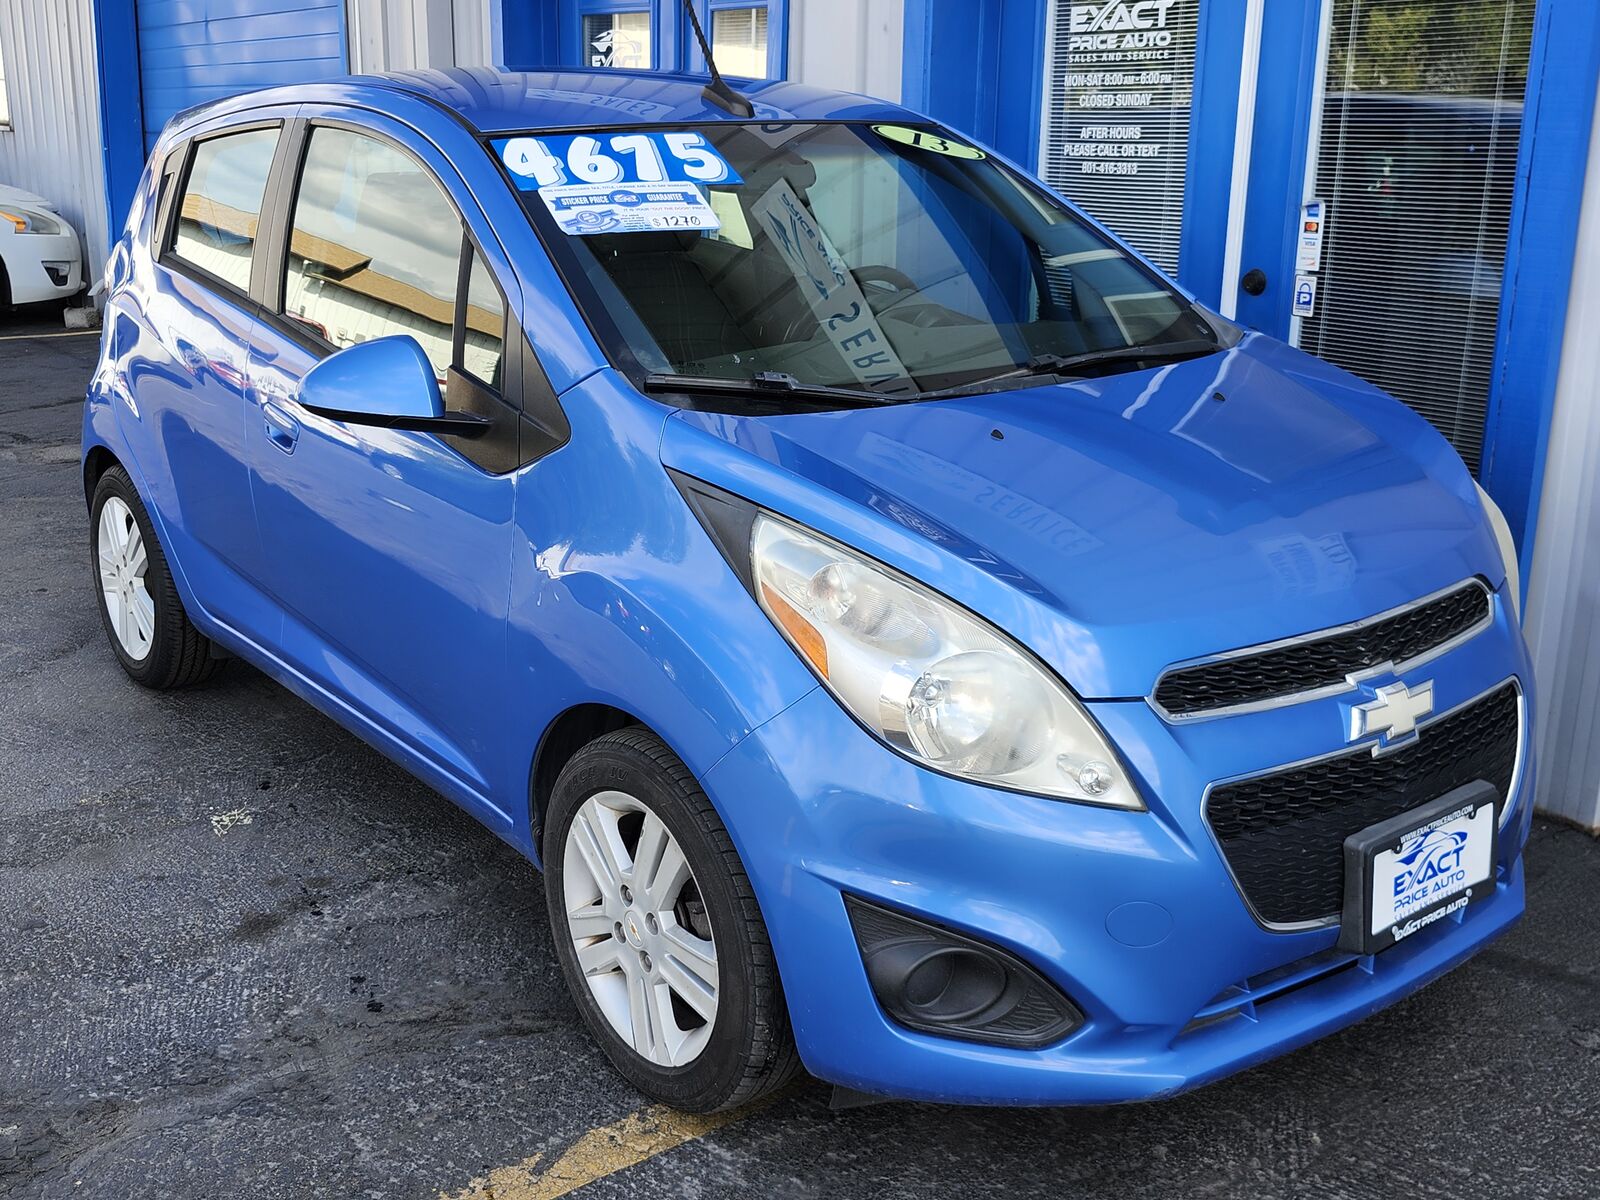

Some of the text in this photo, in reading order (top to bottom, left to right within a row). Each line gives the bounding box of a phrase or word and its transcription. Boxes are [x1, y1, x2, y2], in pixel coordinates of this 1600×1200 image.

[1069, 0, 1175, 32] EXACT
[1068, 31, 1172, 51] PRICE AUTO
[1068, 50, 1169, 63] SALES AND SERVICE
[1064, 73, 1104, 87] MON-SAT
[1140, 72, 1160, 84] 6:00
[1079, 93, 1152, 107] CLOSED SUNDAY
[912, 132, 950, 152] 13
[1080, 127, 1141, 139] AFTER HOURS
[502, 133, 728, 186] 4675
[1063, 144, 1160, 157] PLEASE CALL OR TEXT
[560, 196, 589, 206] STICKER
[589, 195, 610, 204] PRICE
[646, 193, 685, 201] GUARANTEE
[1399, 803, 1474, 844] WWW.EXACTPRICEAUTO.COM
[1393, 844, 1467, 898] EXACT
[1393, 869, 1466, 913] PRICE AUTO
[1421, 906, 1447, 928] PRICE
[1446, 896, 1469, 915] AUTO
